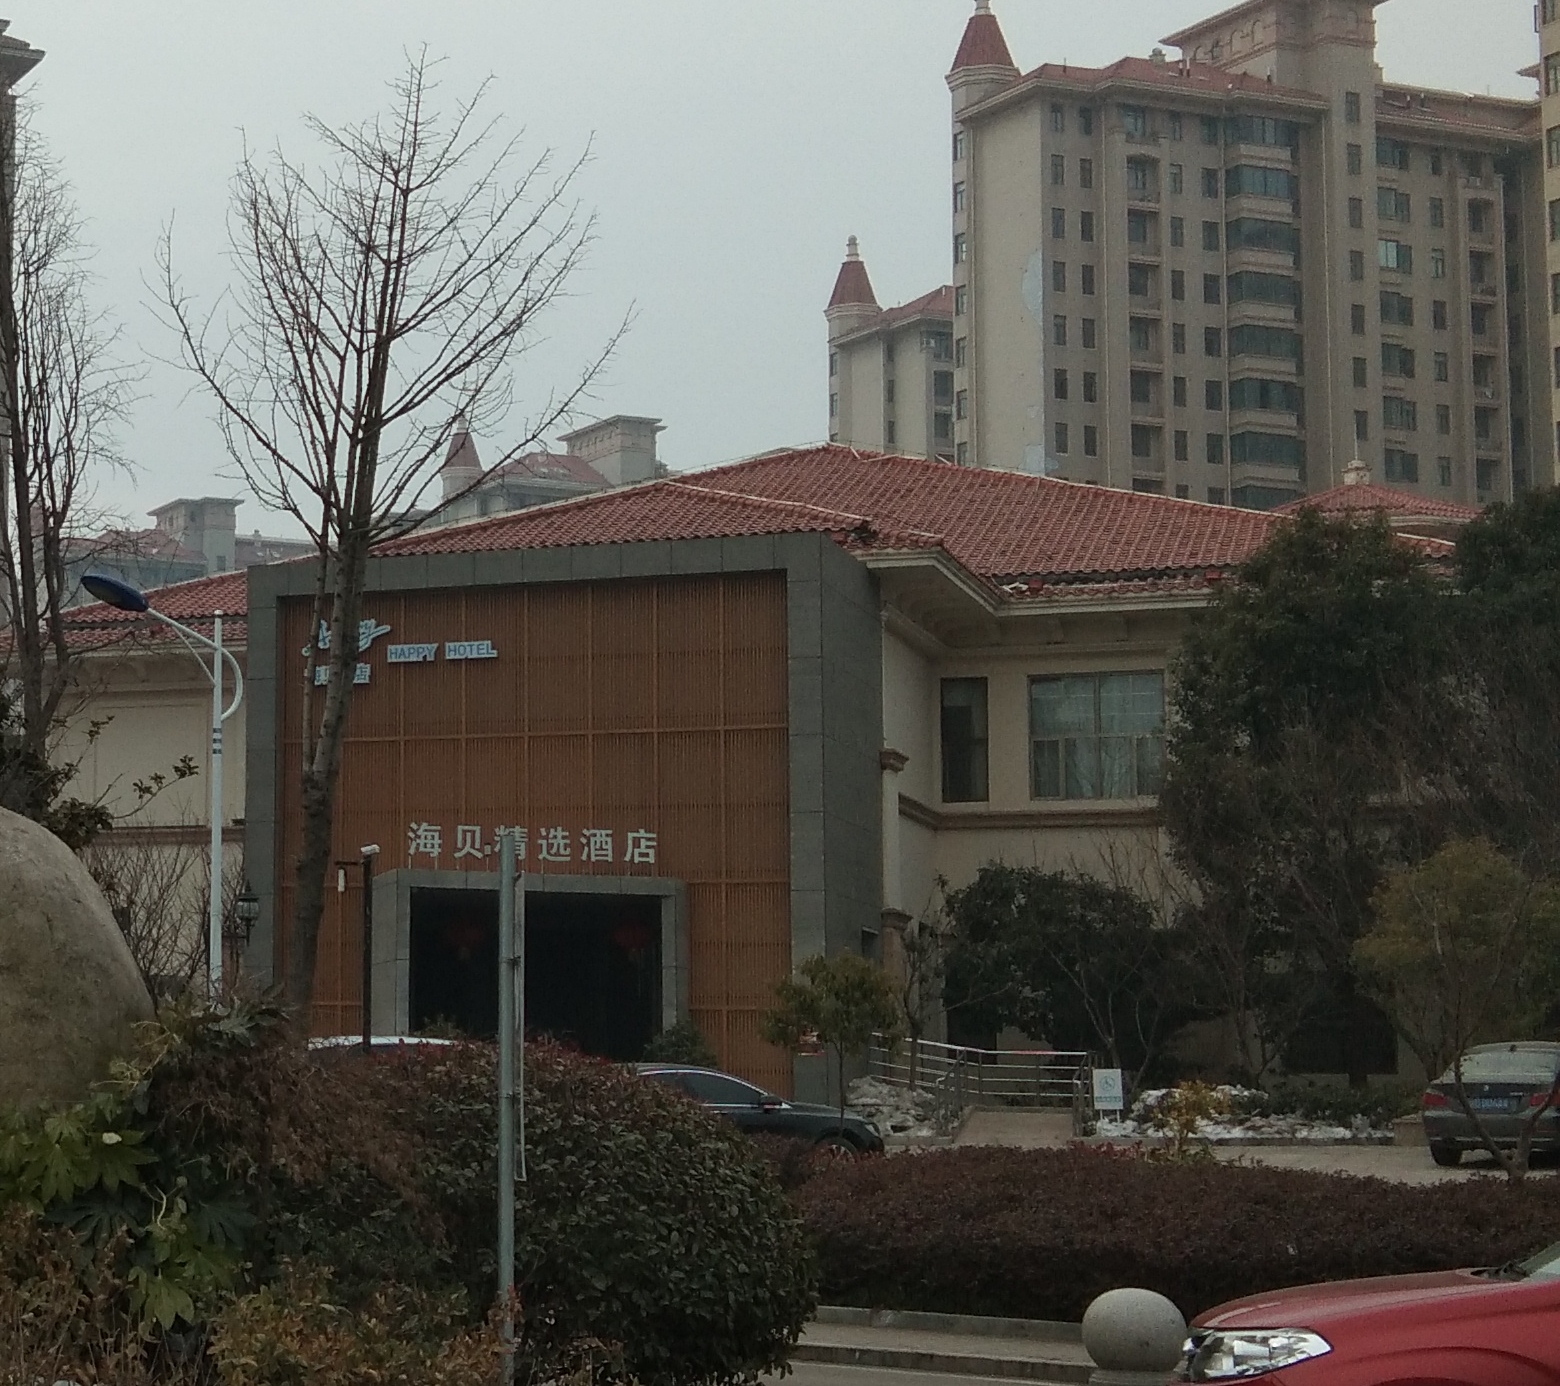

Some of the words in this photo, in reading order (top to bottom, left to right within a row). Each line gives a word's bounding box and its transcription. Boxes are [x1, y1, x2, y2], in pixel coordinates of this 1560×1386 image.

[388, 644, 437, 660] HAPPY
[446, 642, 496, 658] HOTEL
[407, 822, 657, 863] 海贝精选酒店
